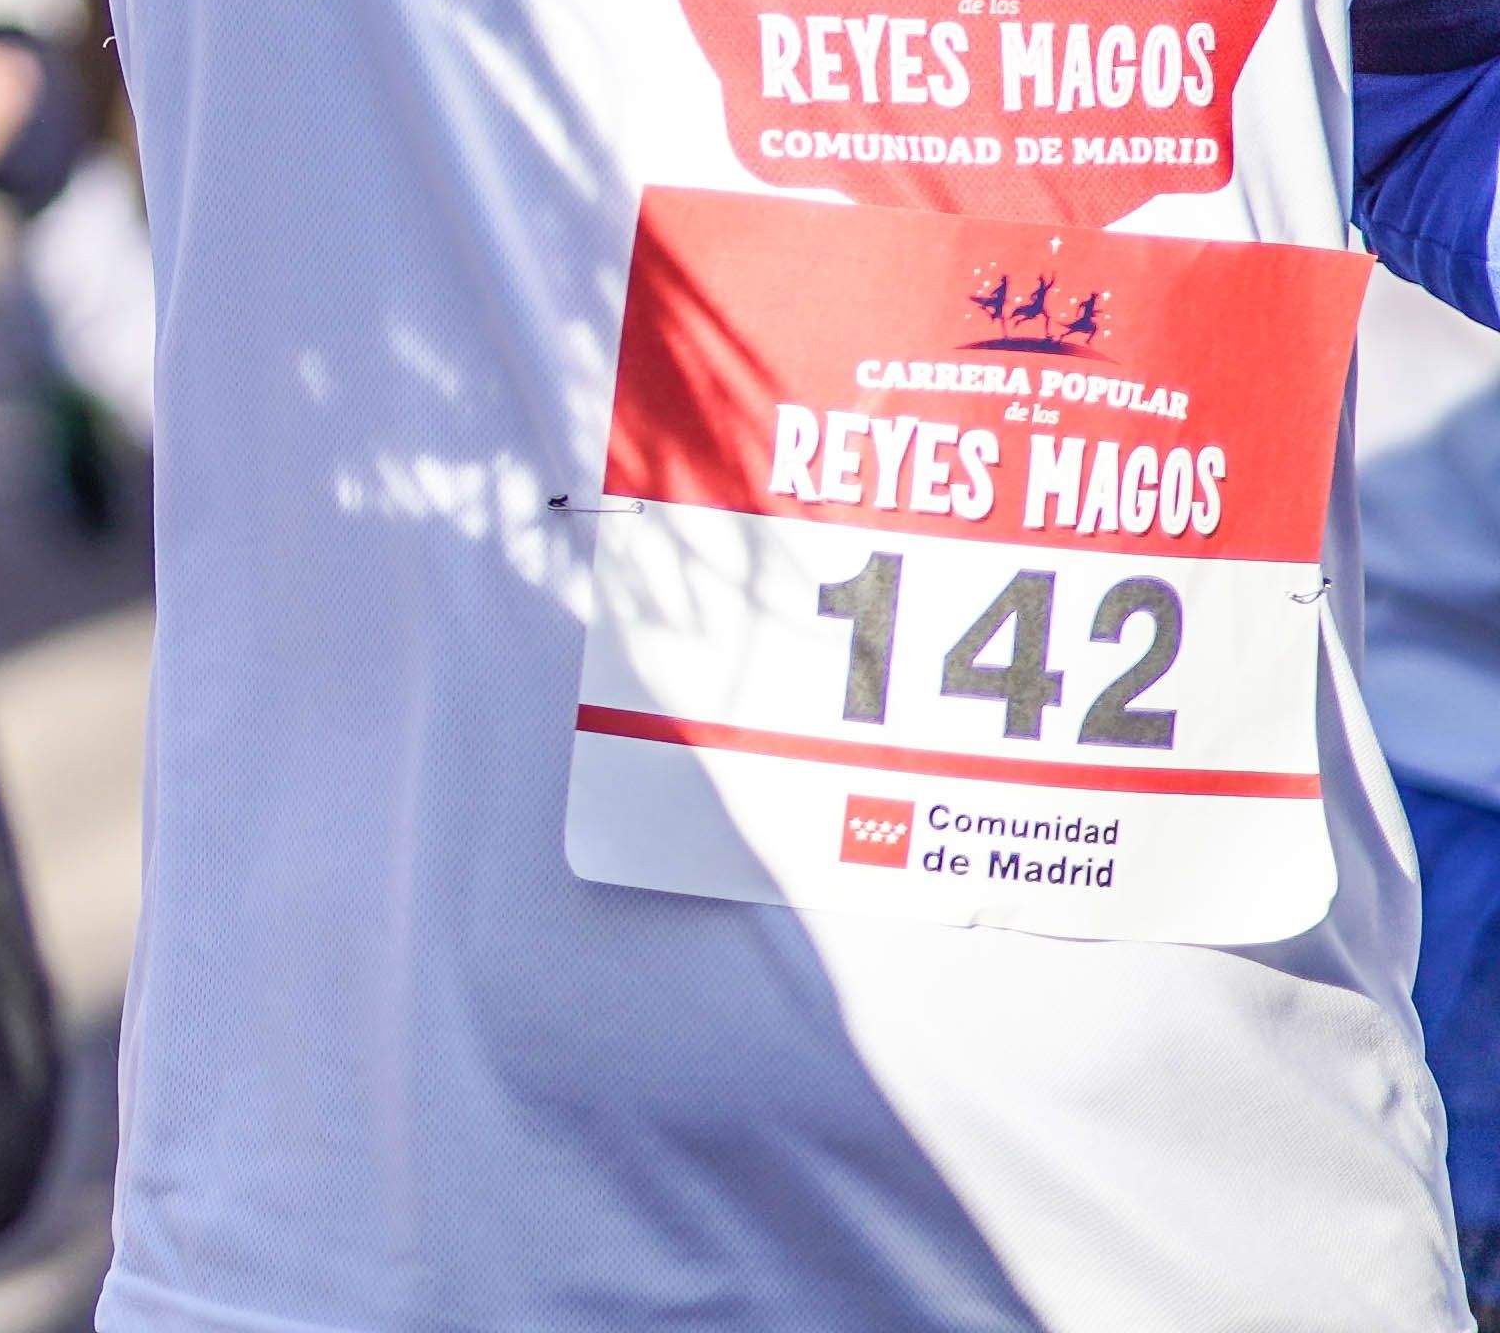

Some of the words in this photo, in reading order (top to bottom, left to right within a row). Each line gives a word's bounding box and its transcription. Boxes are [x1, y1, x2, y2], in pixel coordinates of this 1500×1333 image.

[757, 13, 970, 108] REYES
[999, 21, 1217, 112] MAGOS
[760, 129, 1002, 164] COMUNIDAD
[1015, 136, 1063, 166] DE
[1072, 136, 1219, 166] MADRID
[855, 359, 1031, 396] CARRERA
[1040, 369, 1189, 420] POPULAR
[1004, 401, 1028, 423] de
[1032, 402, 1060, 425] los
[768, 403, 1000, 521] REYES
[1022, 433, 1226, 537] MAGOS
[816, 550, 1184, 750] 142
[928, 804, 1120, 845] Comunidad
[923, 845, 970, 875] de
[988, 850, 1115, 888] Madrid
